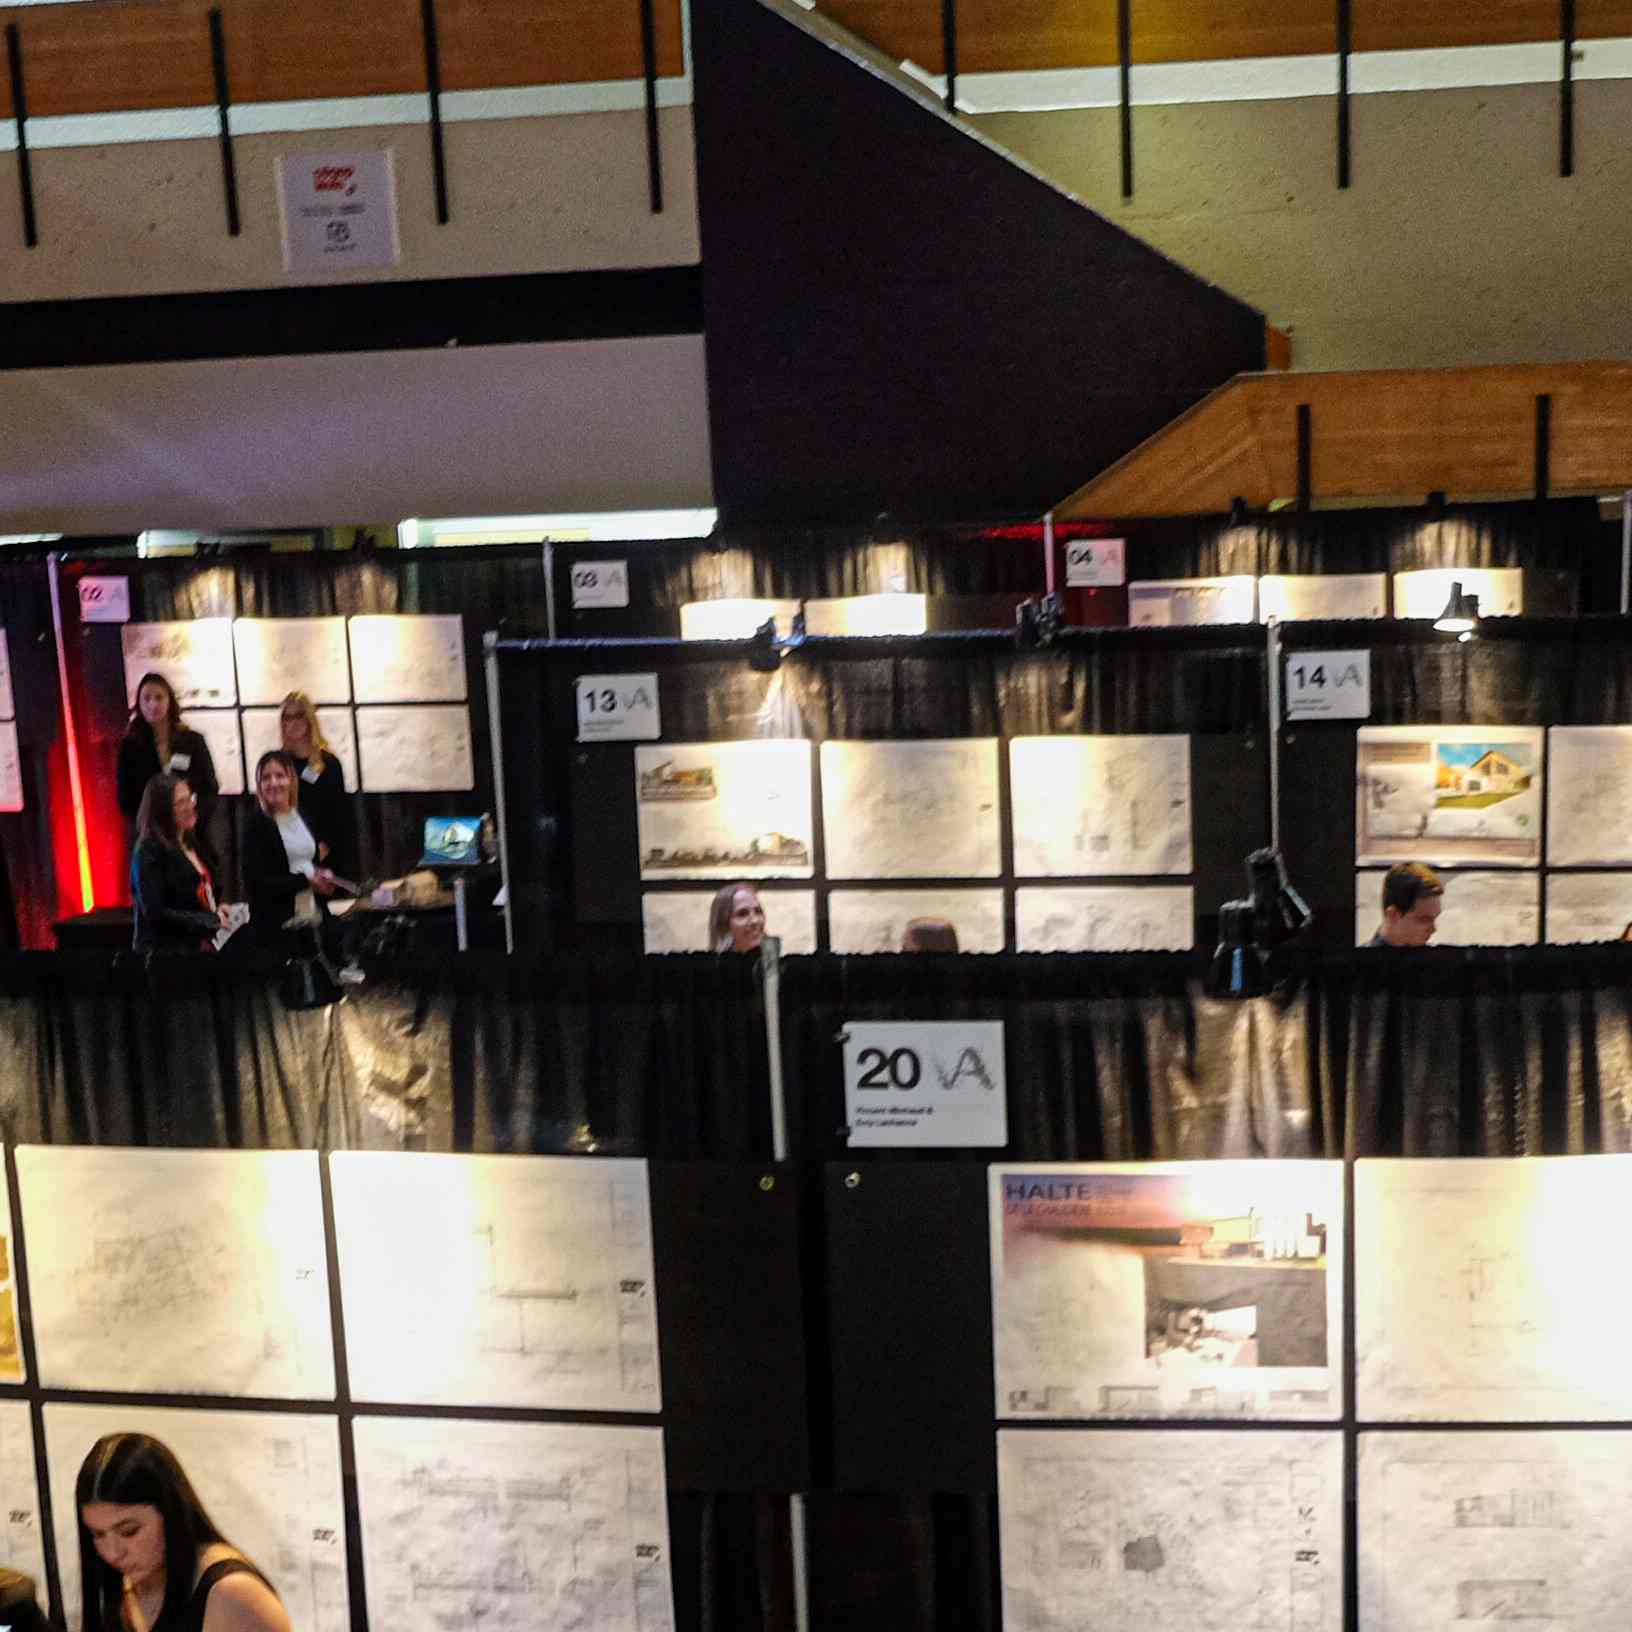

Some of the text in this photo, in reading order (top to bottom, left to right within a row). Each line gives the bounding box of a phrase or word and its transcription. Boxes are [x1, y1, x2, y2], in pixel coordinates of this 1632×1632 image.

[1294, 664, 1326, 690] 14
[585, 689, 617, 713] 13
[856, 1047, 921, 1091] 20
[1005, 1183, 1091, 1200] HALTE
